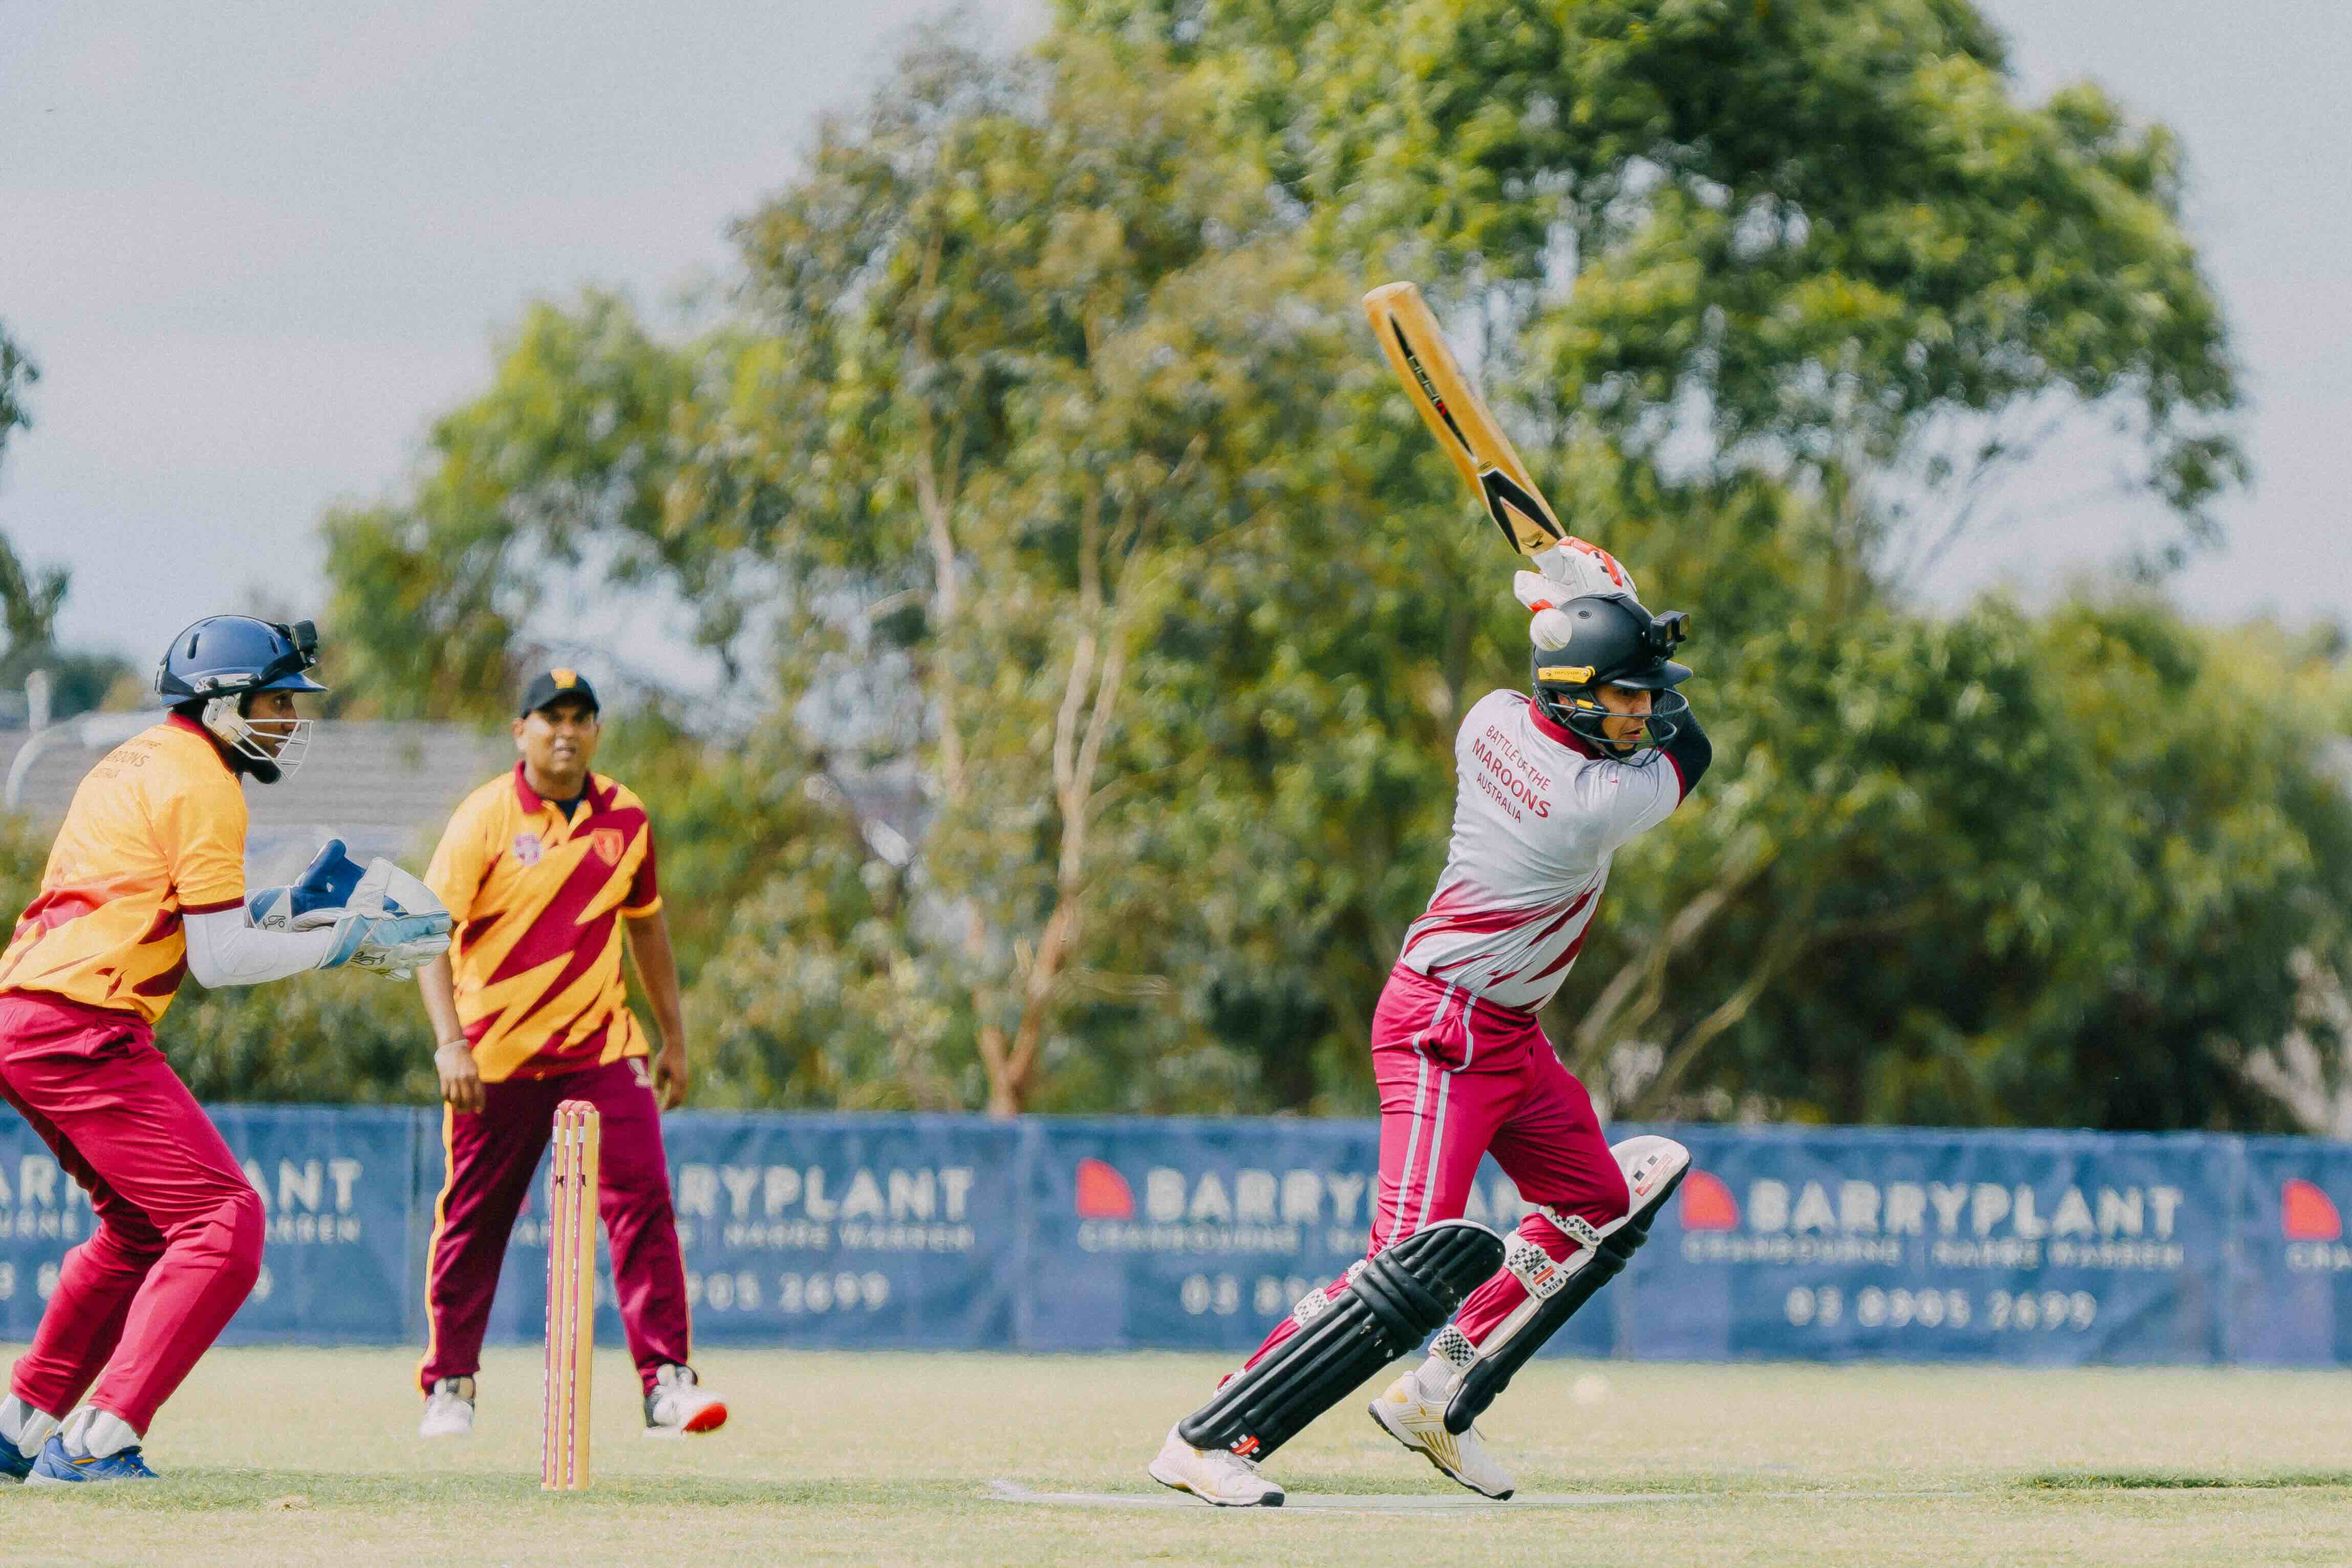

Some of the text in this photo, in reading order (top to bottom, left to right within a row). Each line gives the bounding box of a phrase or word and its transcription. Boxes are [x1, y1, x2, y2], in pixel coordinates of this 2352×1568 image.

[1472, 737, 1551, 818] MAROONS
[1486, 725, 1551, 791] BATTLE OF THE
[1477, 772, 1522, 824] AUSTRALIA
[677, 1162, 975, 1221] RYPLANT
[1747, 1179, 2186, 1240] BARRYPLANT
